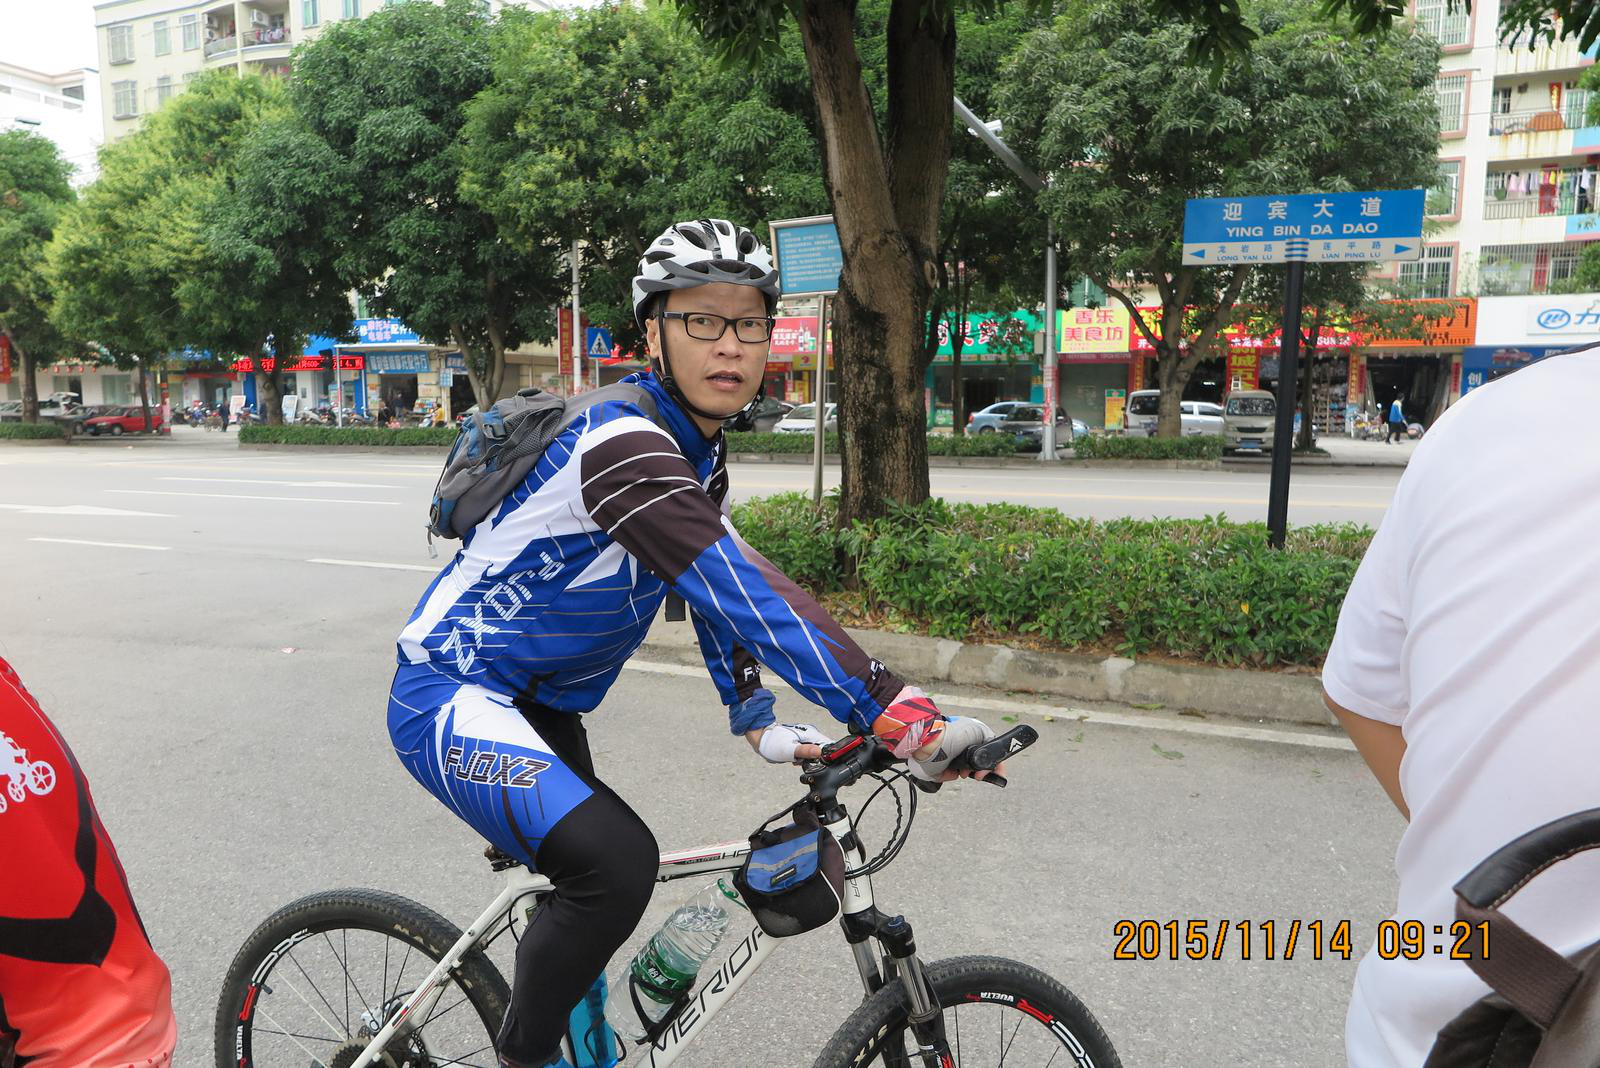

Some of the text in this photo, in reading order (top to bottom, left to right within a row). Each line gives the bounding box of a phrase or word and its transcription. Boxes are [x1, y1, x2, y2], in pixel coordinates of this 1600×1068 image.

[1223, 197, 1382, 222] 迎宾大道
[1226, 222, 1379, 238] YING BIN DA DAO
[1064, 327, 1124, 341] 美食坊
[443, 745, 552, 789] FJOXZ
[980, 991, 1015, 1003] VUELTA
[235, 1024, 244, 1061] VUELTA
